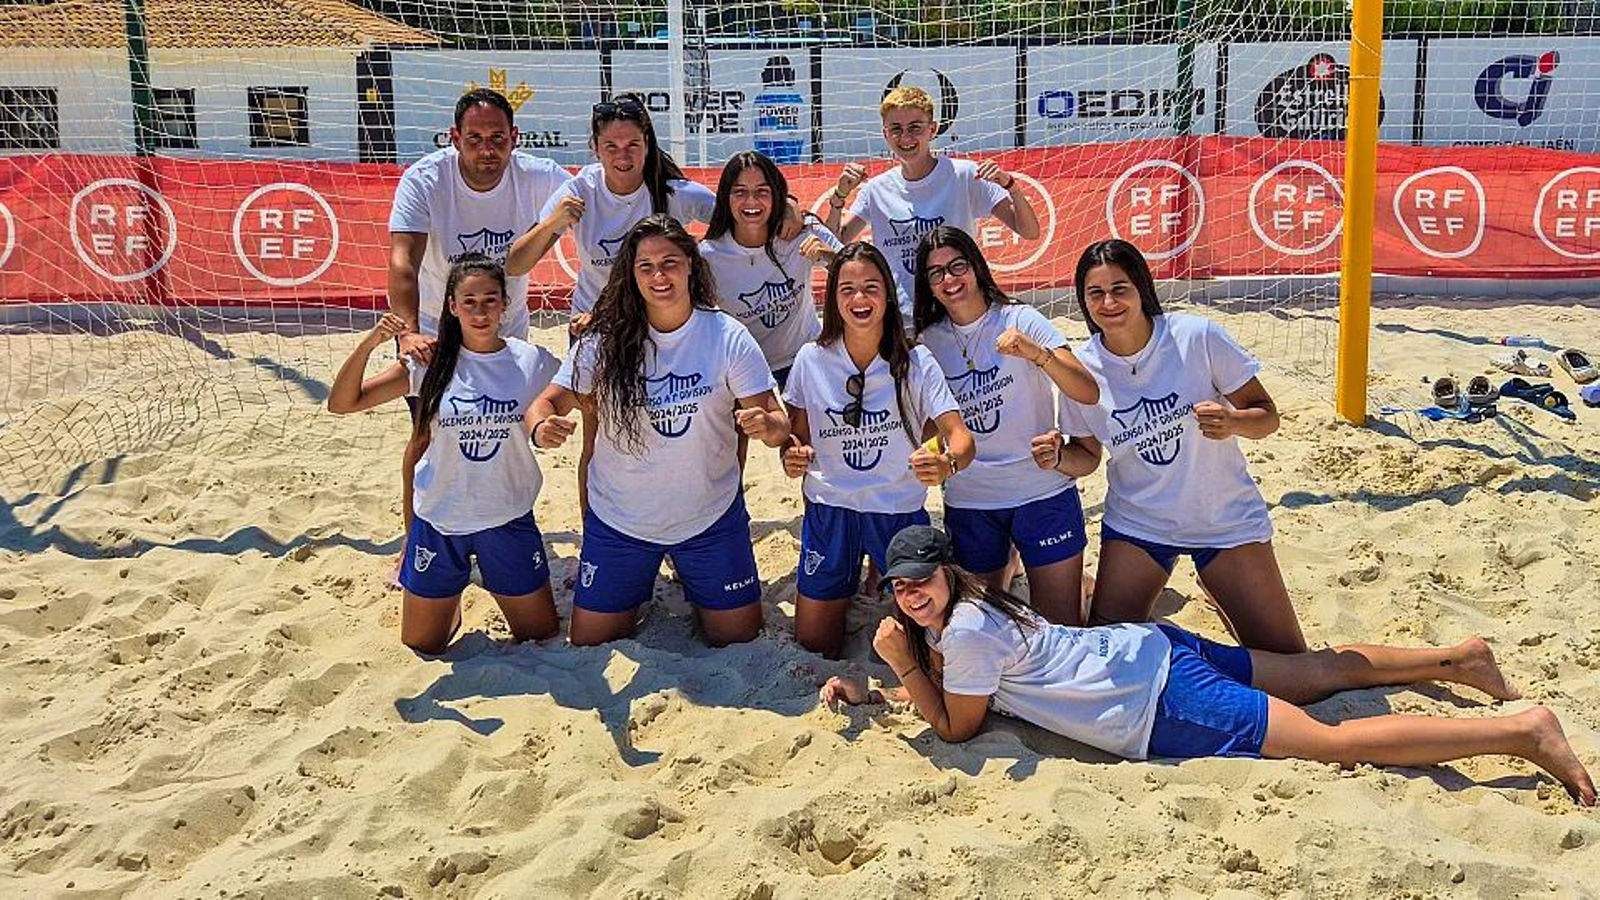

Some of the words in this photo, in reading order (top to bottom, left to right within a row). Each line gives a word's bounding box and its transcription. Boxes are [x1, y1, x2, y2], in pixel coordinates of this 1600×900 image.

[1279, 84, 1349, 106] Estrell
[459, 427, 510, 441] 2024/2025
[1136, 423, 1184, 452] 2024/2025
[841, 436, 888, 451] 2024/2025
